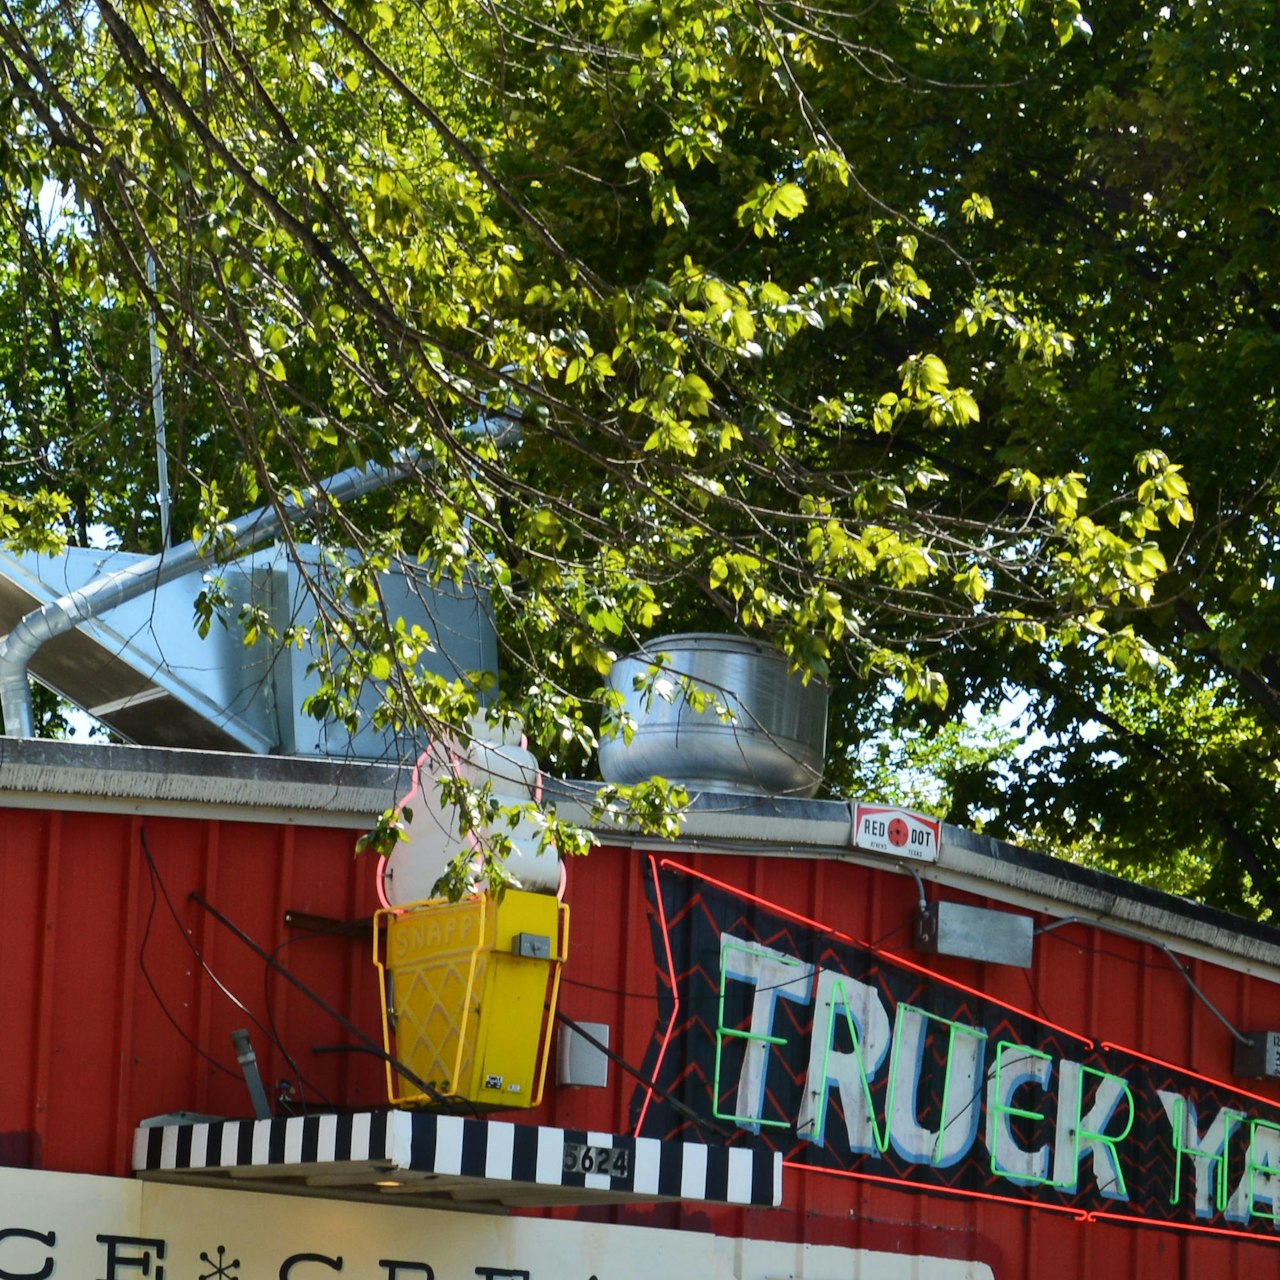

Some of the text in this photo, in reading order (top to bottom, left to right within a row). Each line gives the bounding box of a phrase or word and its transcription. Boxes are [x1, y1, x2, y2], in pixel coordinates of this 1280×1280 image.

[864, 819, 932, 847] RED DOT
[720, 932, 1129, 1201] TRUCK
[564, 1144, 626, 1176] 5624
